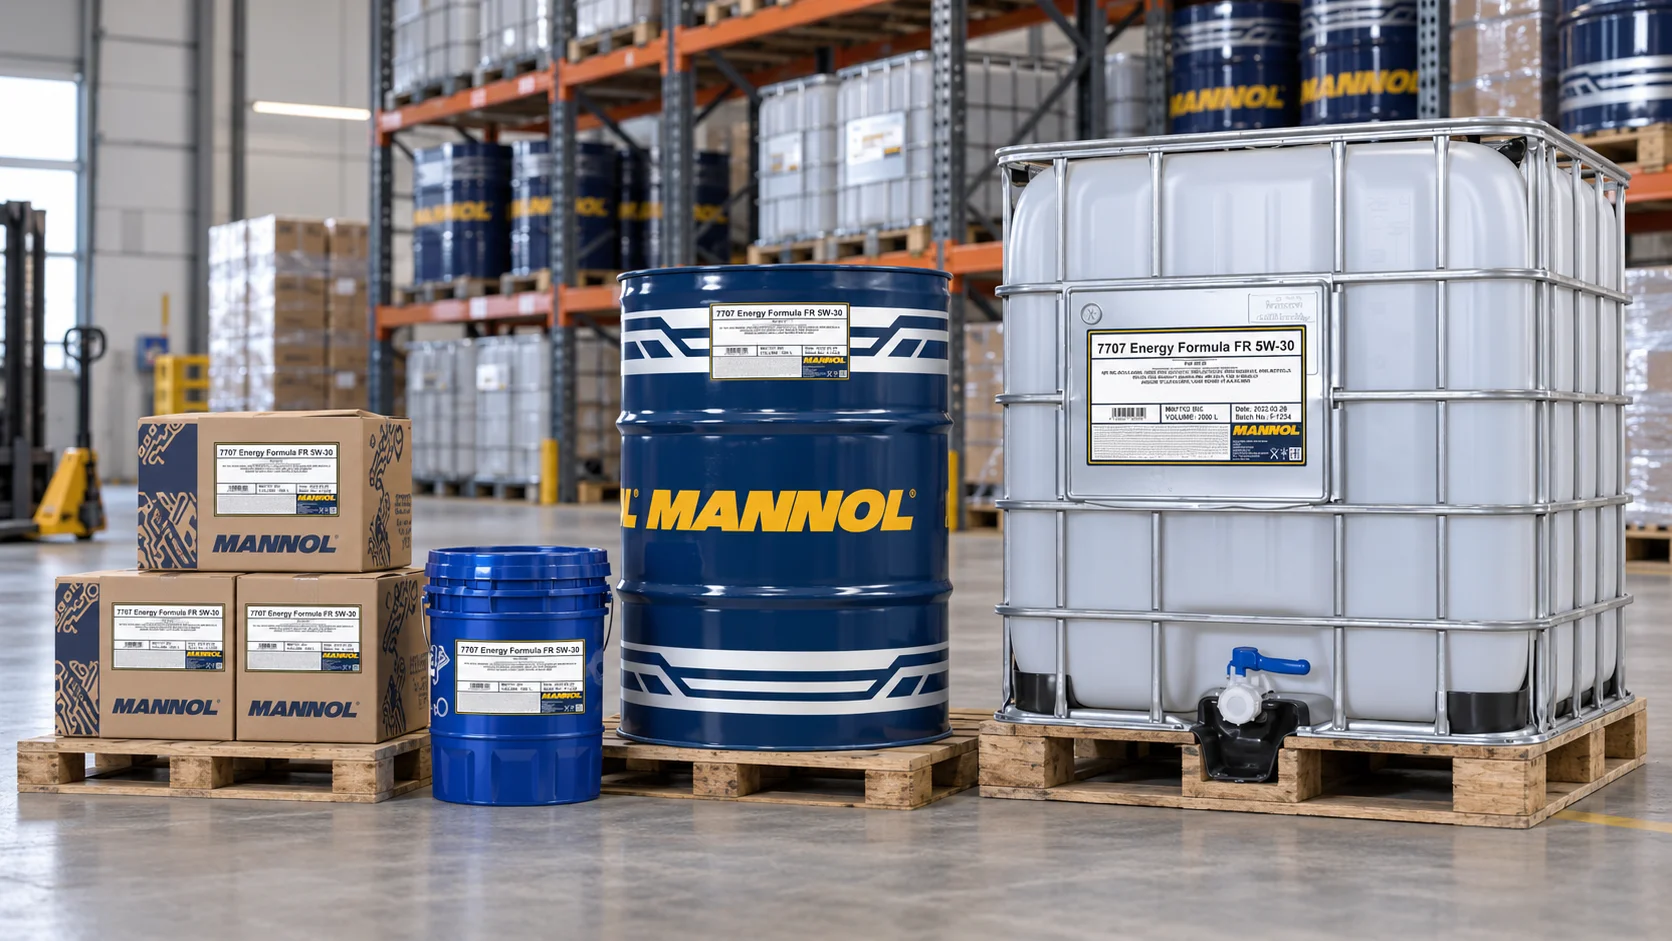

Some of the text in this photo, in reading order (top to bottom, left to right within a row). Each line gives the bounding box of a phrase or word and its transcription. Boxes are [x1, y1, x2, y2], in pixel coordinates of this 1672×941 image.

[716, 309, 735, 317] 7707
[737, 310, 766, 318] Energy
[768, 309, 802, 317] Formula
[1097, 340, 1295, 356] 7707 Energy Formula FR 5W-30
[1232, 424, 1300, 436] MANNOL
[239, 449, 265, 458] Energy
[646, 488, 914, 532] MANNOL
[212, 534, 336, 554] MANNOL
[480, 646, 507, 655] Energy
[112, 698, 220, 716] MANNOL
[248, 700, 359, 718] MANNOL
